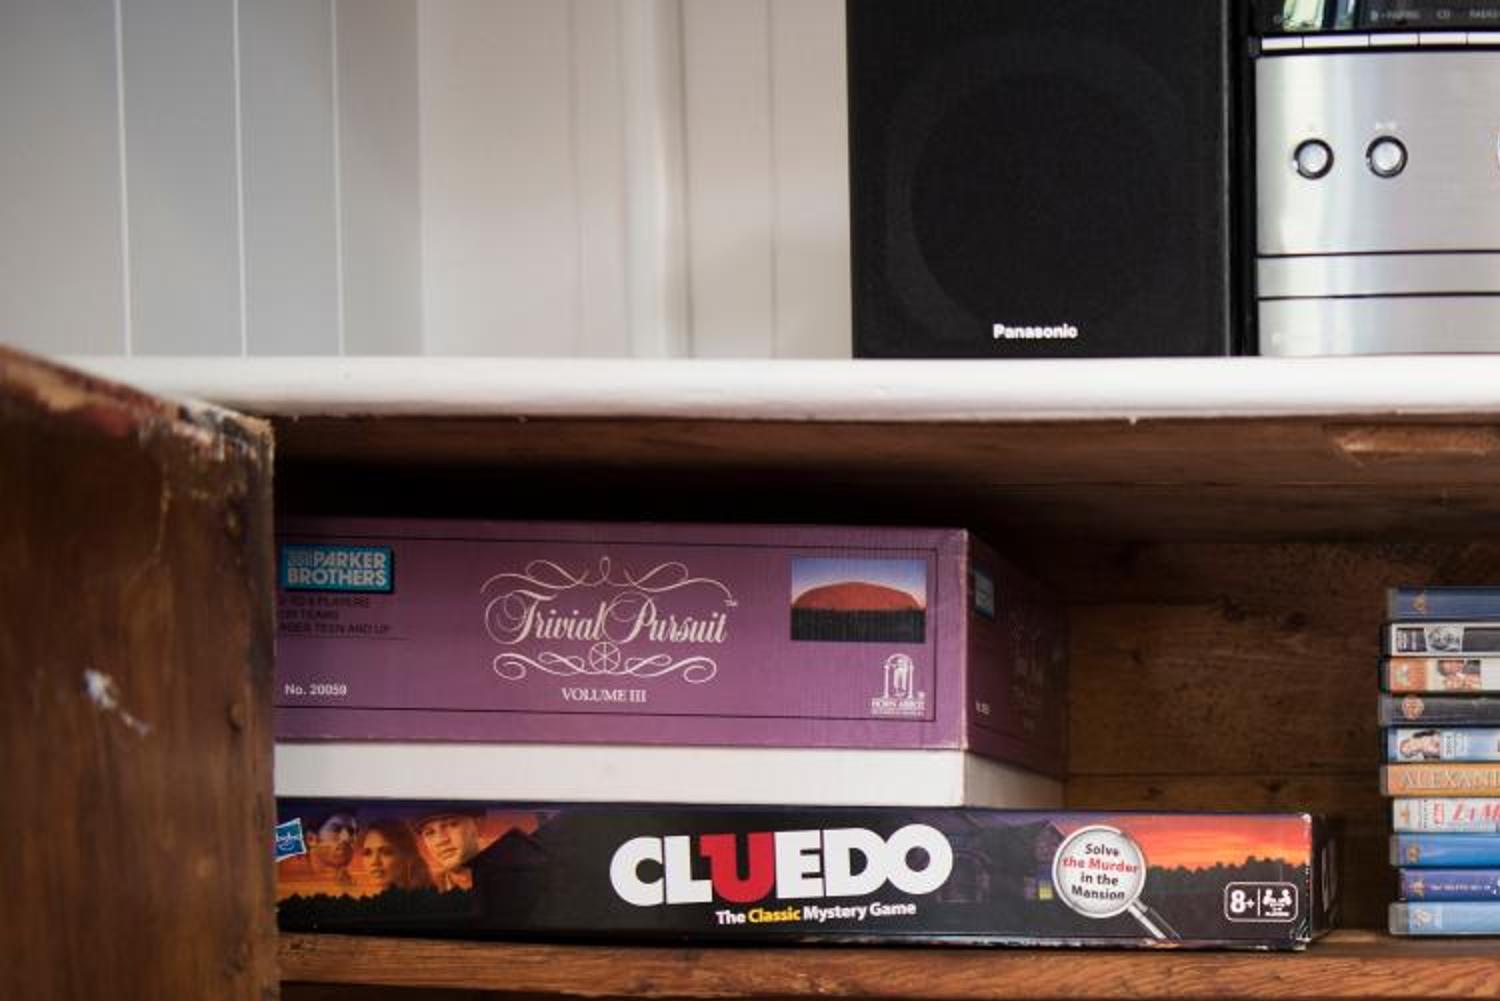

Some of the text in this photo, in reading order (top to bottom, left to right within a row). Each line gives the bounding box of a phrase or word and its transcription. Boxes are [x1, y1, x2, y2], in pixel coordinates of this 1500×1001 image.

[992, 322, 1079, 339] Panasonic
[313, 550, 387, 570] PARKER
[287, 567, 387, 587] BROTHERS
[485, 589, 728, 645] Trivial Pursuit
[560, 687, 626, 702] VOLUME
[1085, 843, 1119, 856] Solve
[608, 823, 954, 907] CLUEDO
[1063, 857, 1137, 873] the Murder
[1081, 872, 1119, 886] in the
[1071, 885, 1125, 900] Mansion
[1230, 889, 1255, 914] 8+
[715, 902, 917, 925] The Classic Mystery Game
